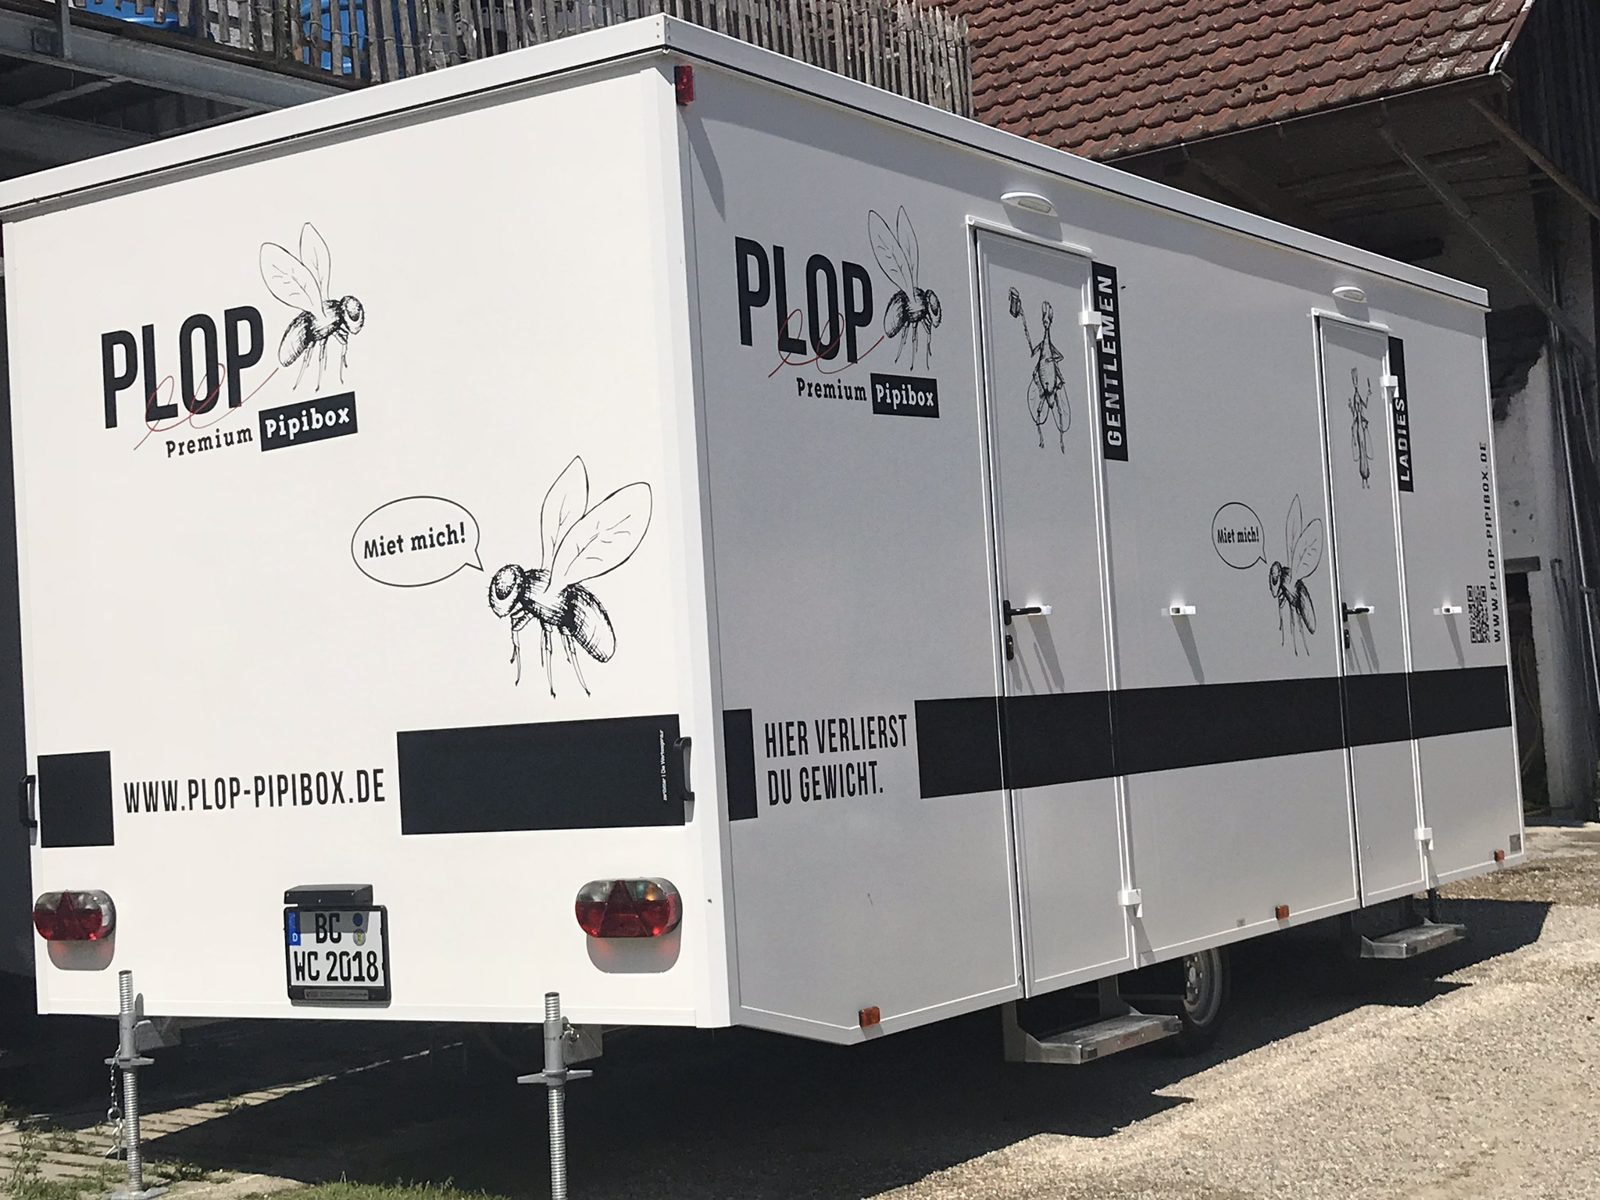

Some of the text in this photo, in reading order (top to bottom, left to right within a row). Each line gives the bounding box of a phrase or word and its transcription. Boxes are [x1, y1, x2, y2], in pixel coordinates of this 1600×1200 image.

[735, 236, 873, 364] PLOP
[101, 305, 264, 429] PLOP
[1097, 275, 1123, 447] GENTLEMEN
[796, 377, 935, 410] Premium Pipibox
[166, 406, 350, 458] Premium Pipibox
[1395, 398, 1410, 482] LADIES
[364, 522, 466, 559] Miet mich!
[1217, 526, 1259, 543] Miet mich!
[1479, 442, 1501, 643] WWW.PLOP-PIPIBOX.DE
[764, 714, 907, 758] HIER VERLIERST
[123, 768, 386, 813] WWW.PLOP-PIPIBOX.DE
[767, 761, 884, 806] DU GEWICHT.
[292, 933, 298, 942] D
[315, 913, 342, 944] BC
[294, 951, 379, 981] WC 2018
